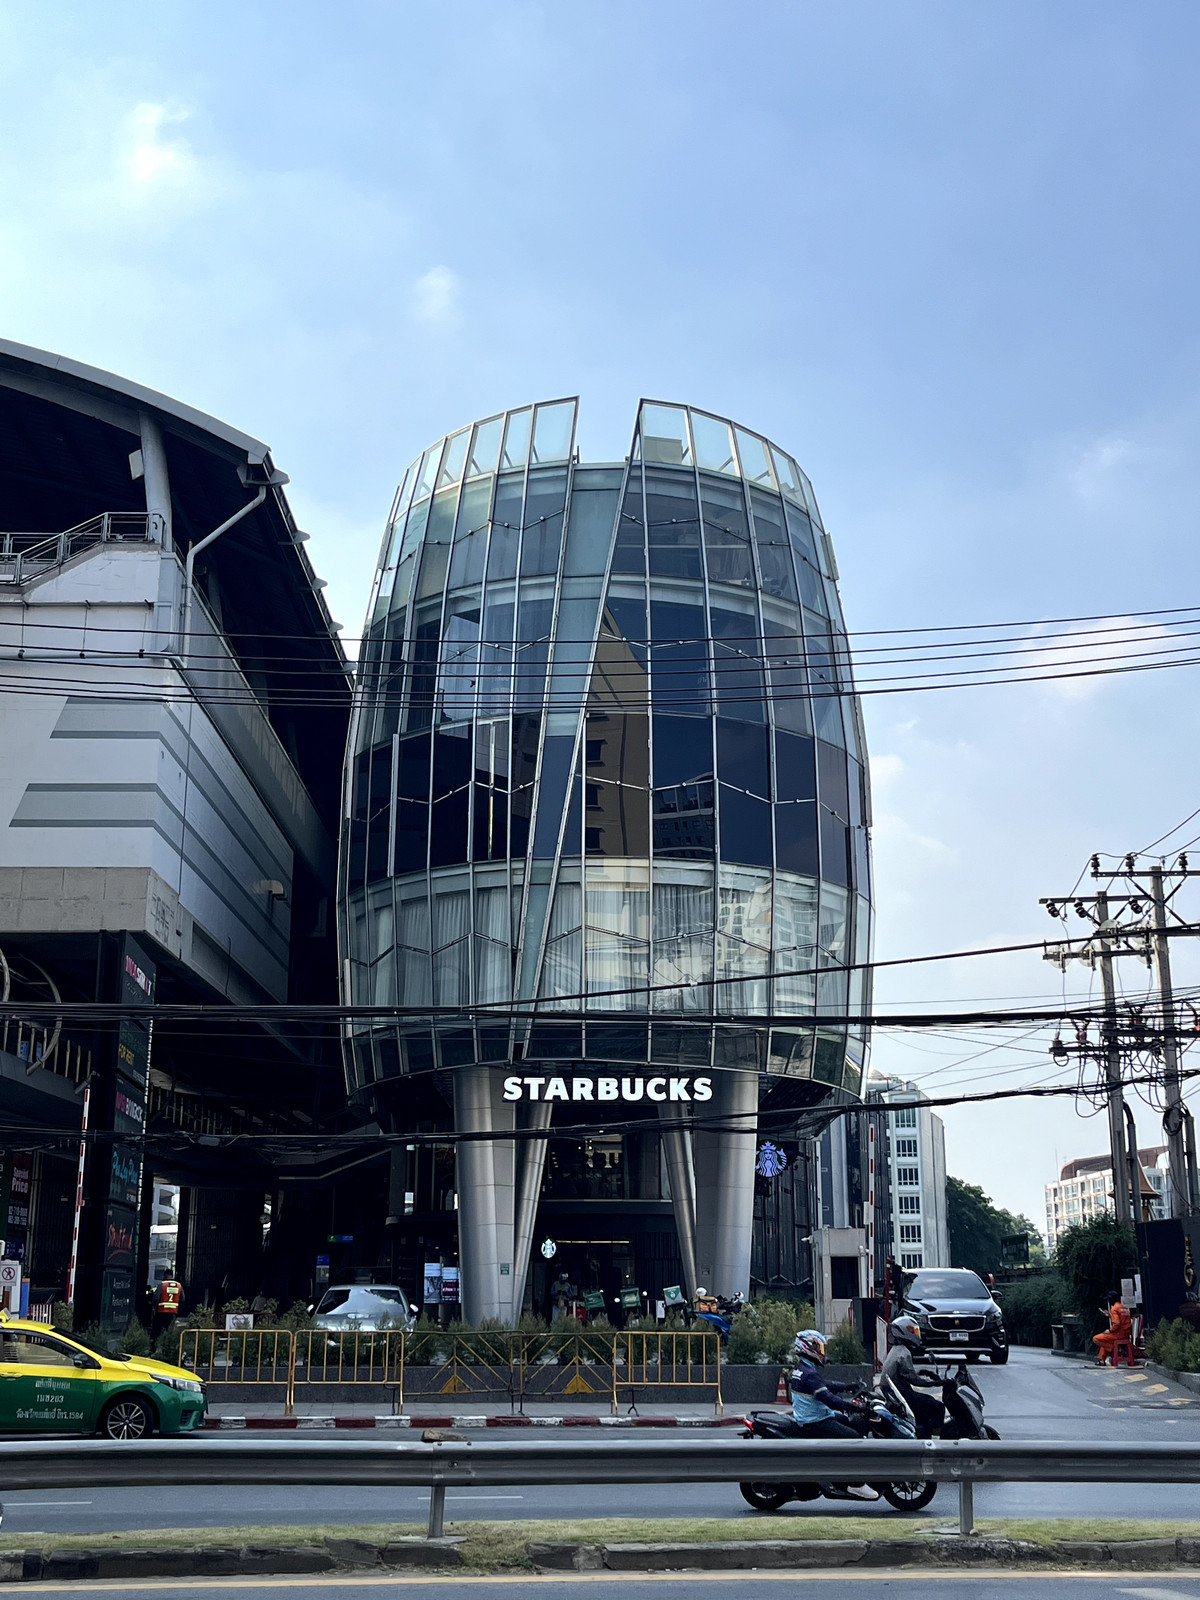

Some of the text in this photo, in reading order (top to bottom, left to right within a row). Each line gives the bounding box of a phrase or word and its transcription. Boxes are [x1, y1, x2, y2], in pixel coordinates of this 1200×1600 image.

[503, 1076, 713, 1101] STARBUCKS
[11, 1177, 29, 1194] Price
[168, 1293, 174, 1302] 2
